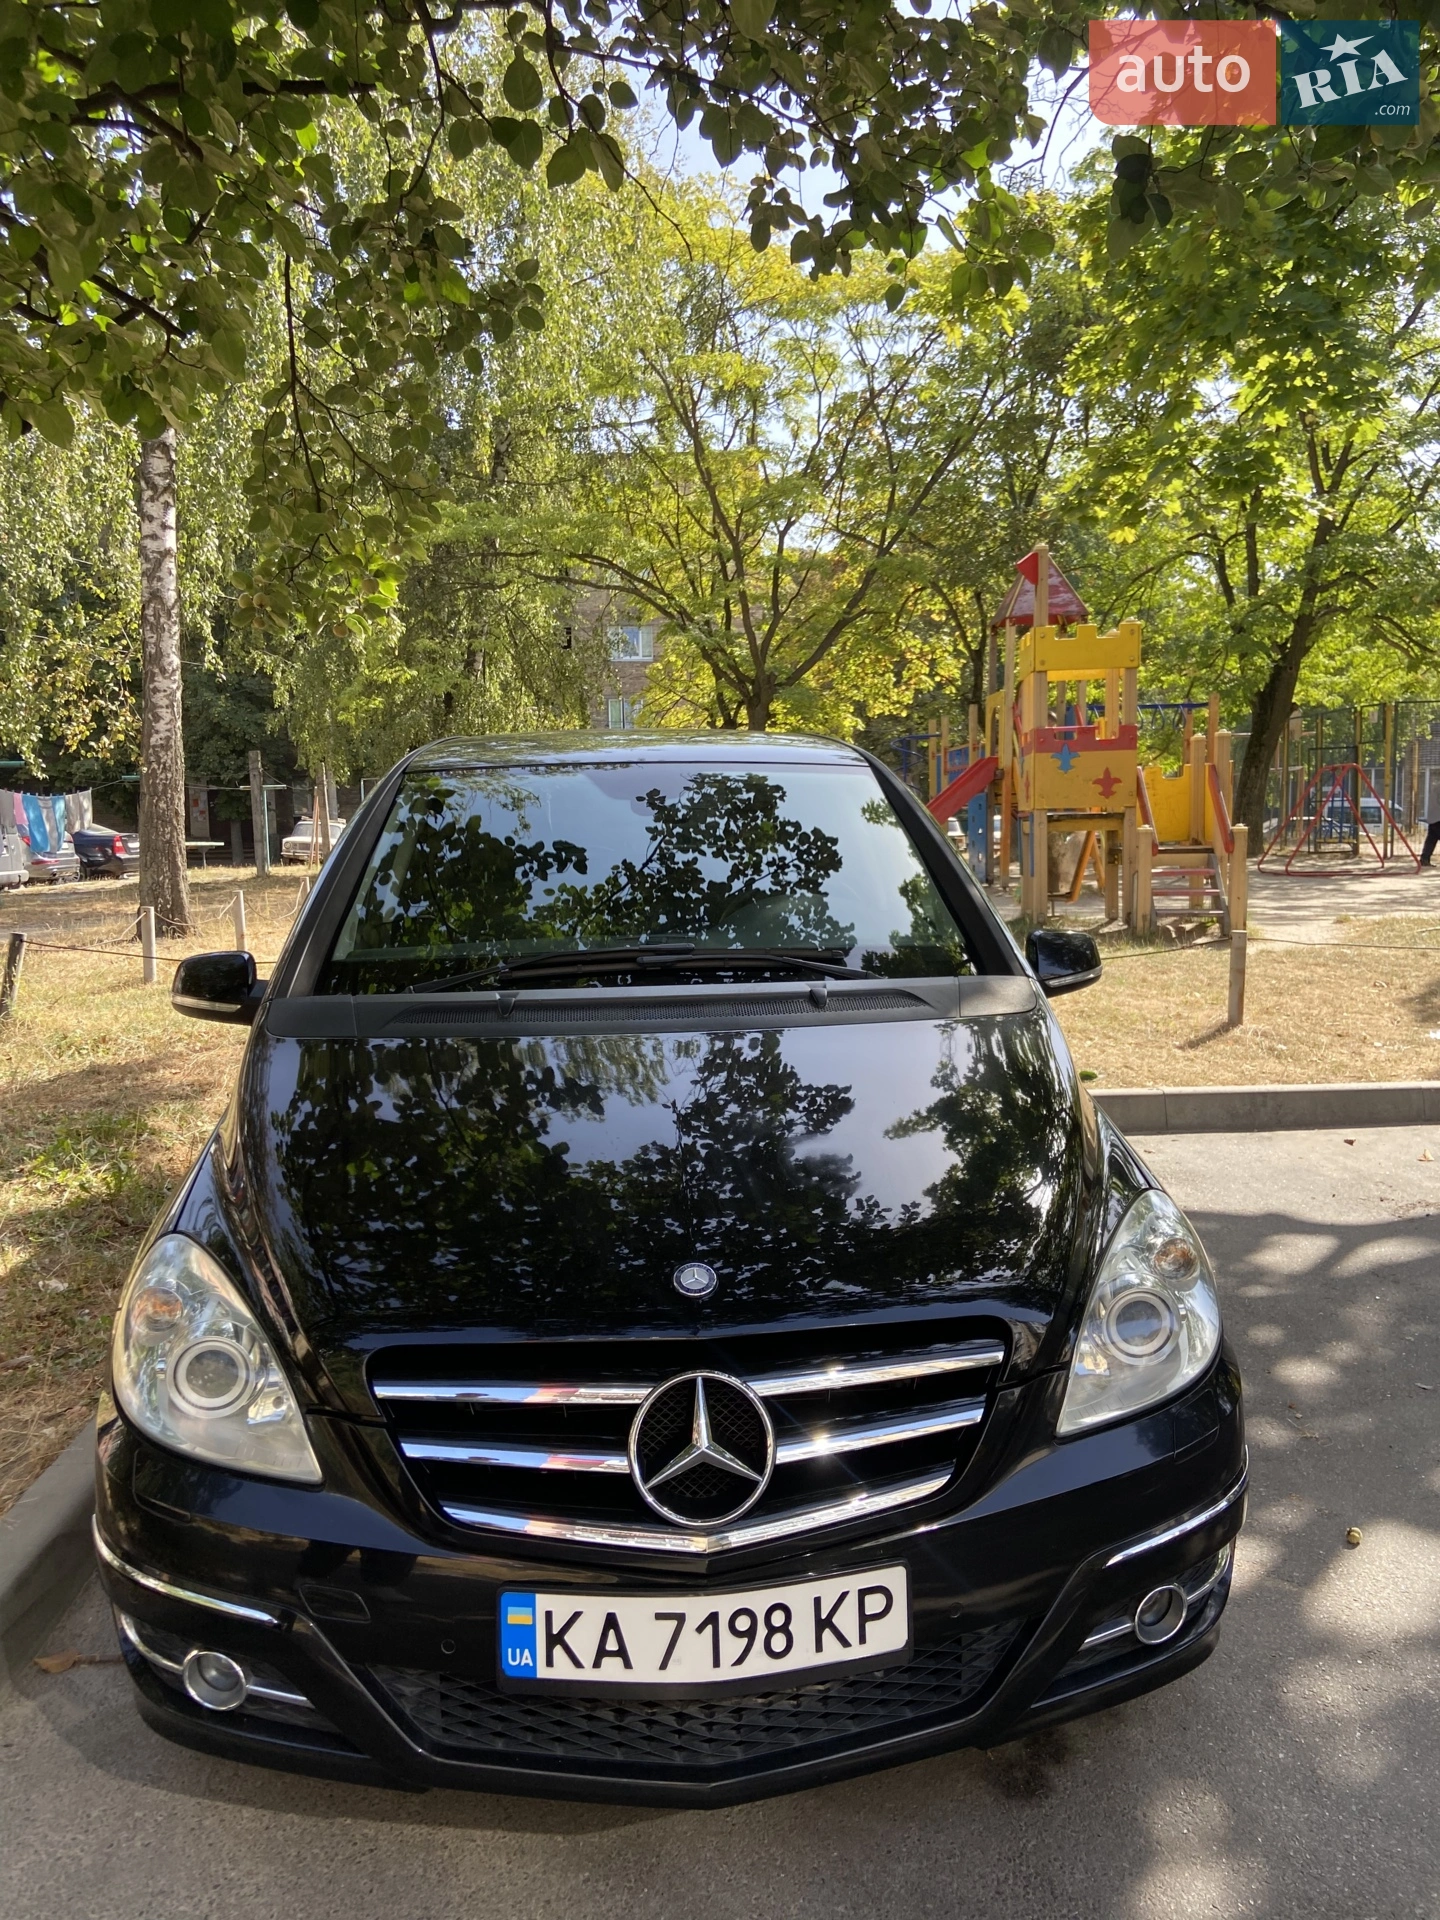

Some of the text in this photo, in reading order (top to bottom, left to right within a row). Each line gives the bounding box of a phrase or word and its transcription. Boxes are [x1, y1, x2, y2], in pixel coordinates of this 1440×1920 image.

[545, 1584, 893, 1671] KA 7198 KP
[507, 1648, 534, 1667] UA
